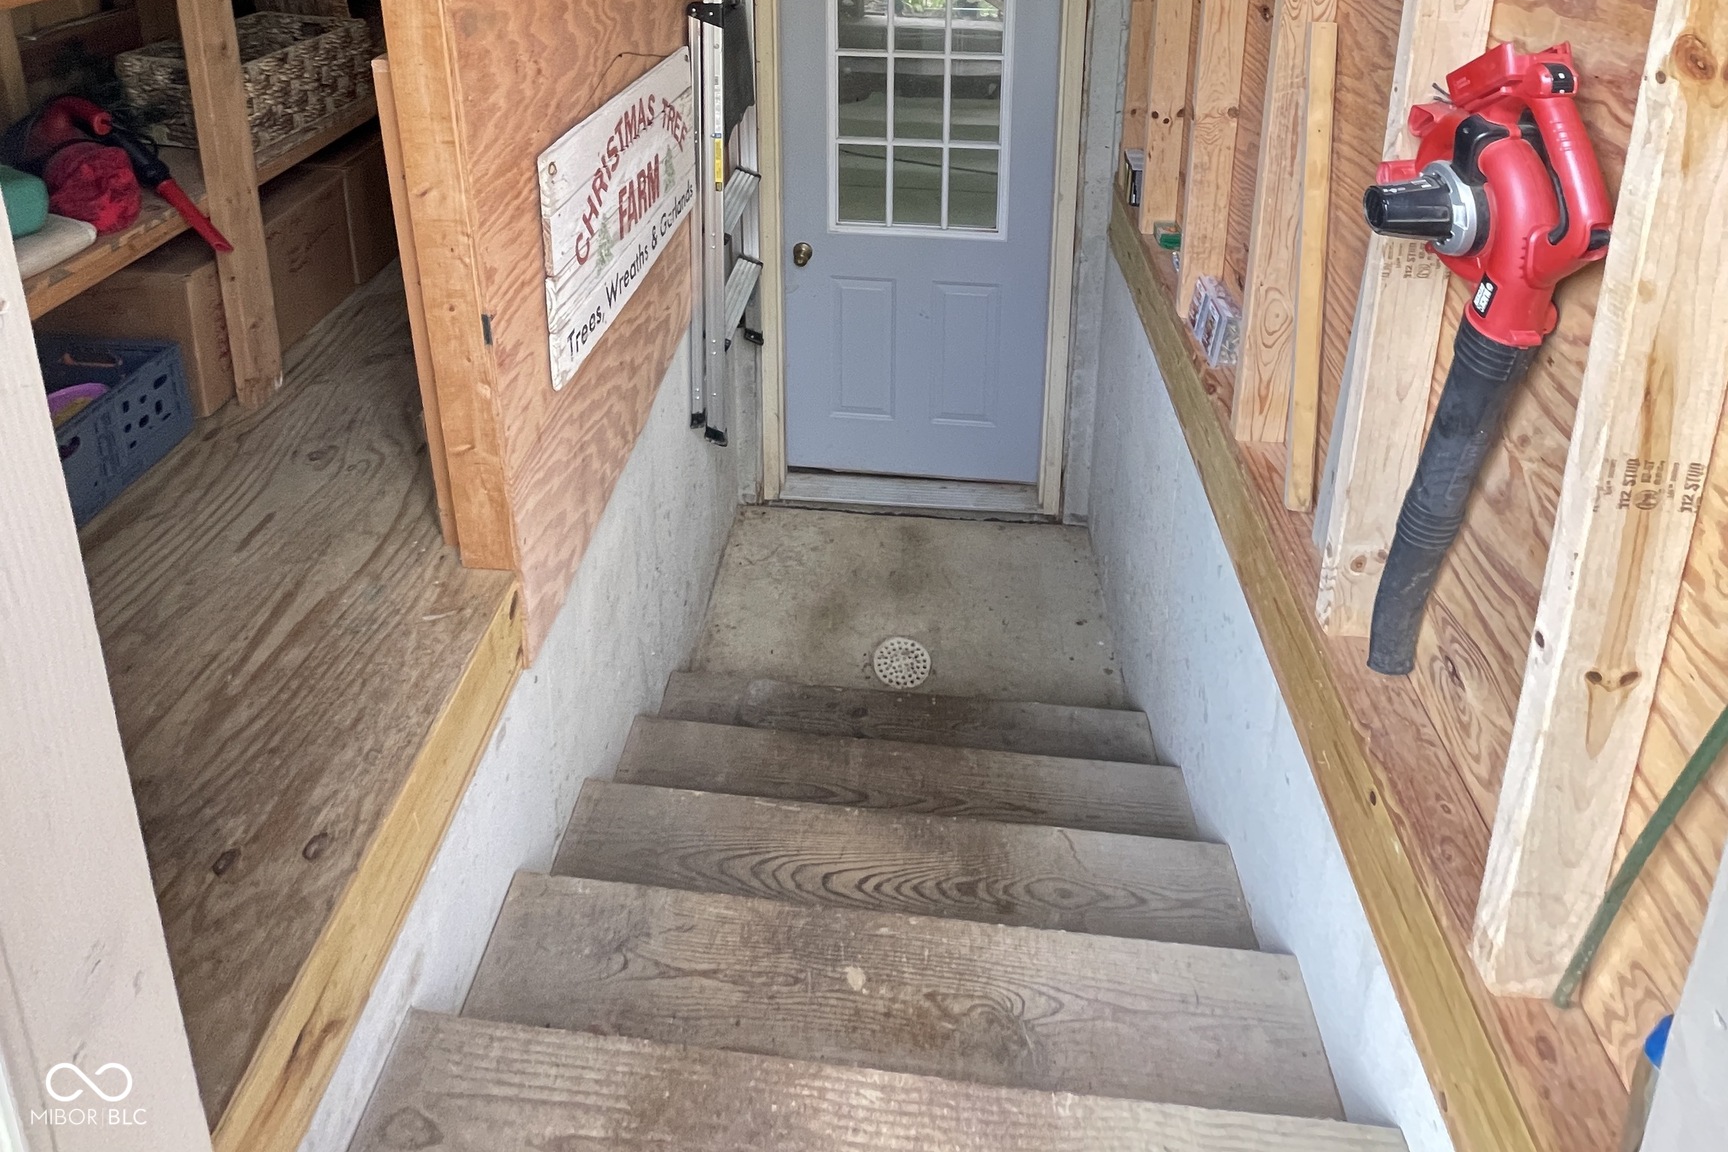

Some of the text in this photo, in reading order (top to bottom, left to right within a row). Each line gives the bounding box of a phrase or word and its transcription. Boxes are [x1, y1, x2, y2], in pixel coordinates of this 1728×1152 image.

[575, 93, 656, 266] CHRISTMAS
[618, 152, 661, 241] FARM
[604, 243, 650, 310] Wreaths
[651, 224, 659, 251] &
